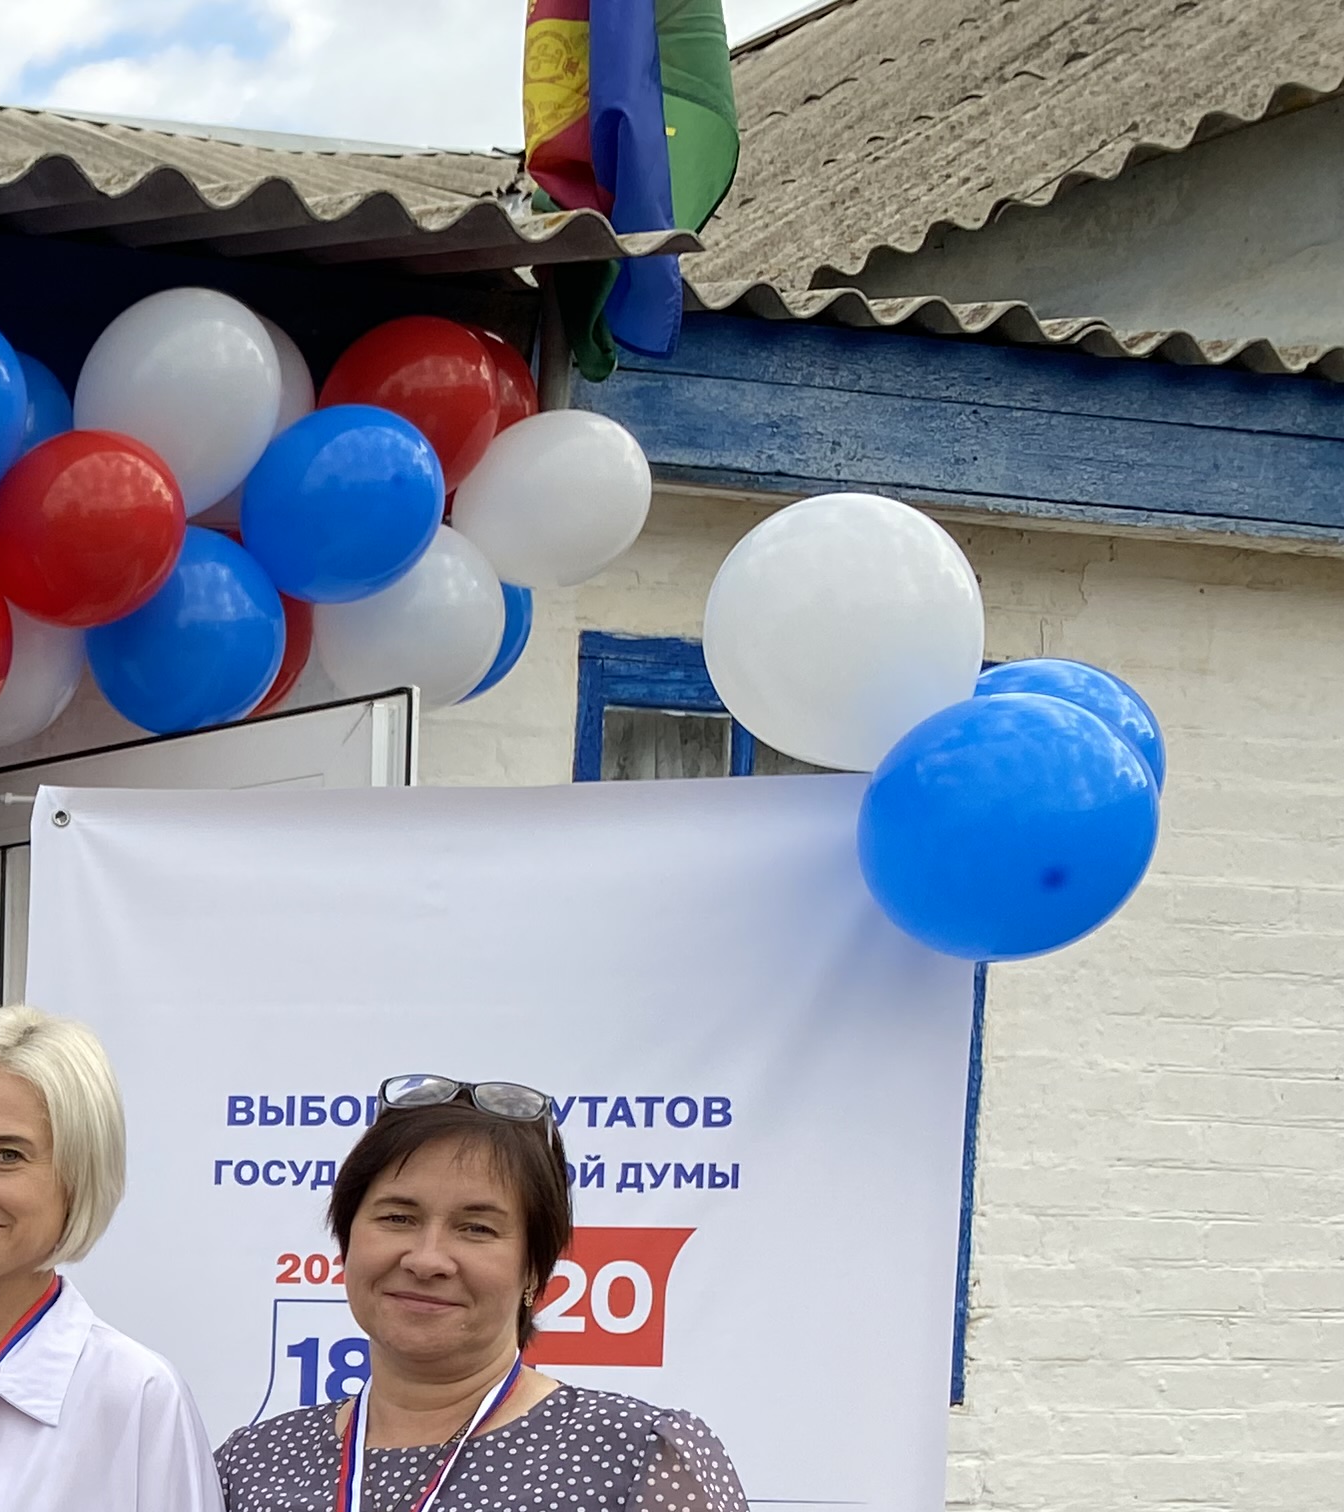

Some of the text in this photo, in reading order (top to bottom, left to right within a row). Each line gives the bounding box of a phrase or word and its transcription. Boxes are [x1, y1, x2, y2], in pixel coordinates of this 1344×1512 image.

[227, 1095, 732, 1128] ВЫБО УТАТОВ
[616, 1161, 739, 1193] ДУМЫ
[532, 1259, 653, 1335] 20
